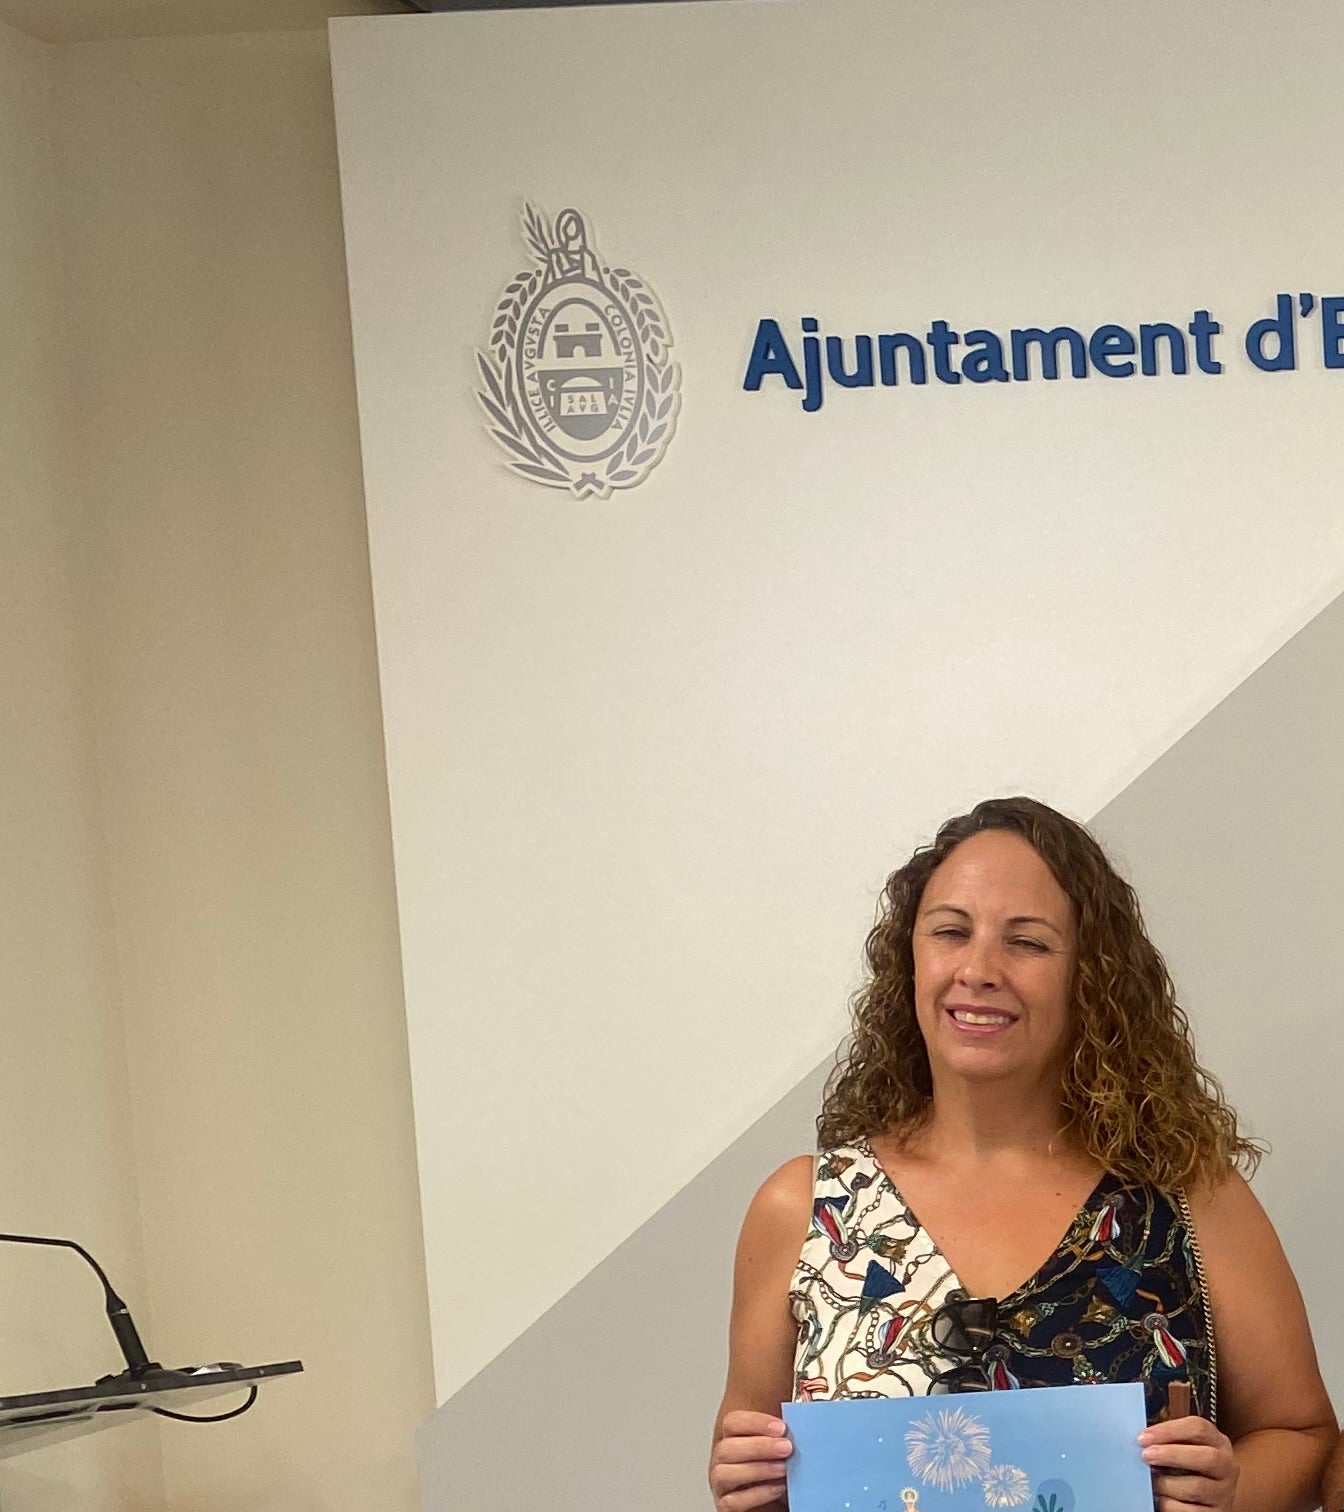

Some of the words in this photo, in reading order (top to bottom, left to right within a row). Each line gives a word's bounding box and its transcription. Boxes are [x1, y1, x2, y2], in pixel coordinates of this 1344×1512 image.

[525, 307, 551, 383] AVGVSTA
[605, 305, 636, 381] COLONIA
[743, 309, 1222, 411] Ajuntament
[611, 390, 635, 430] IVLIA
